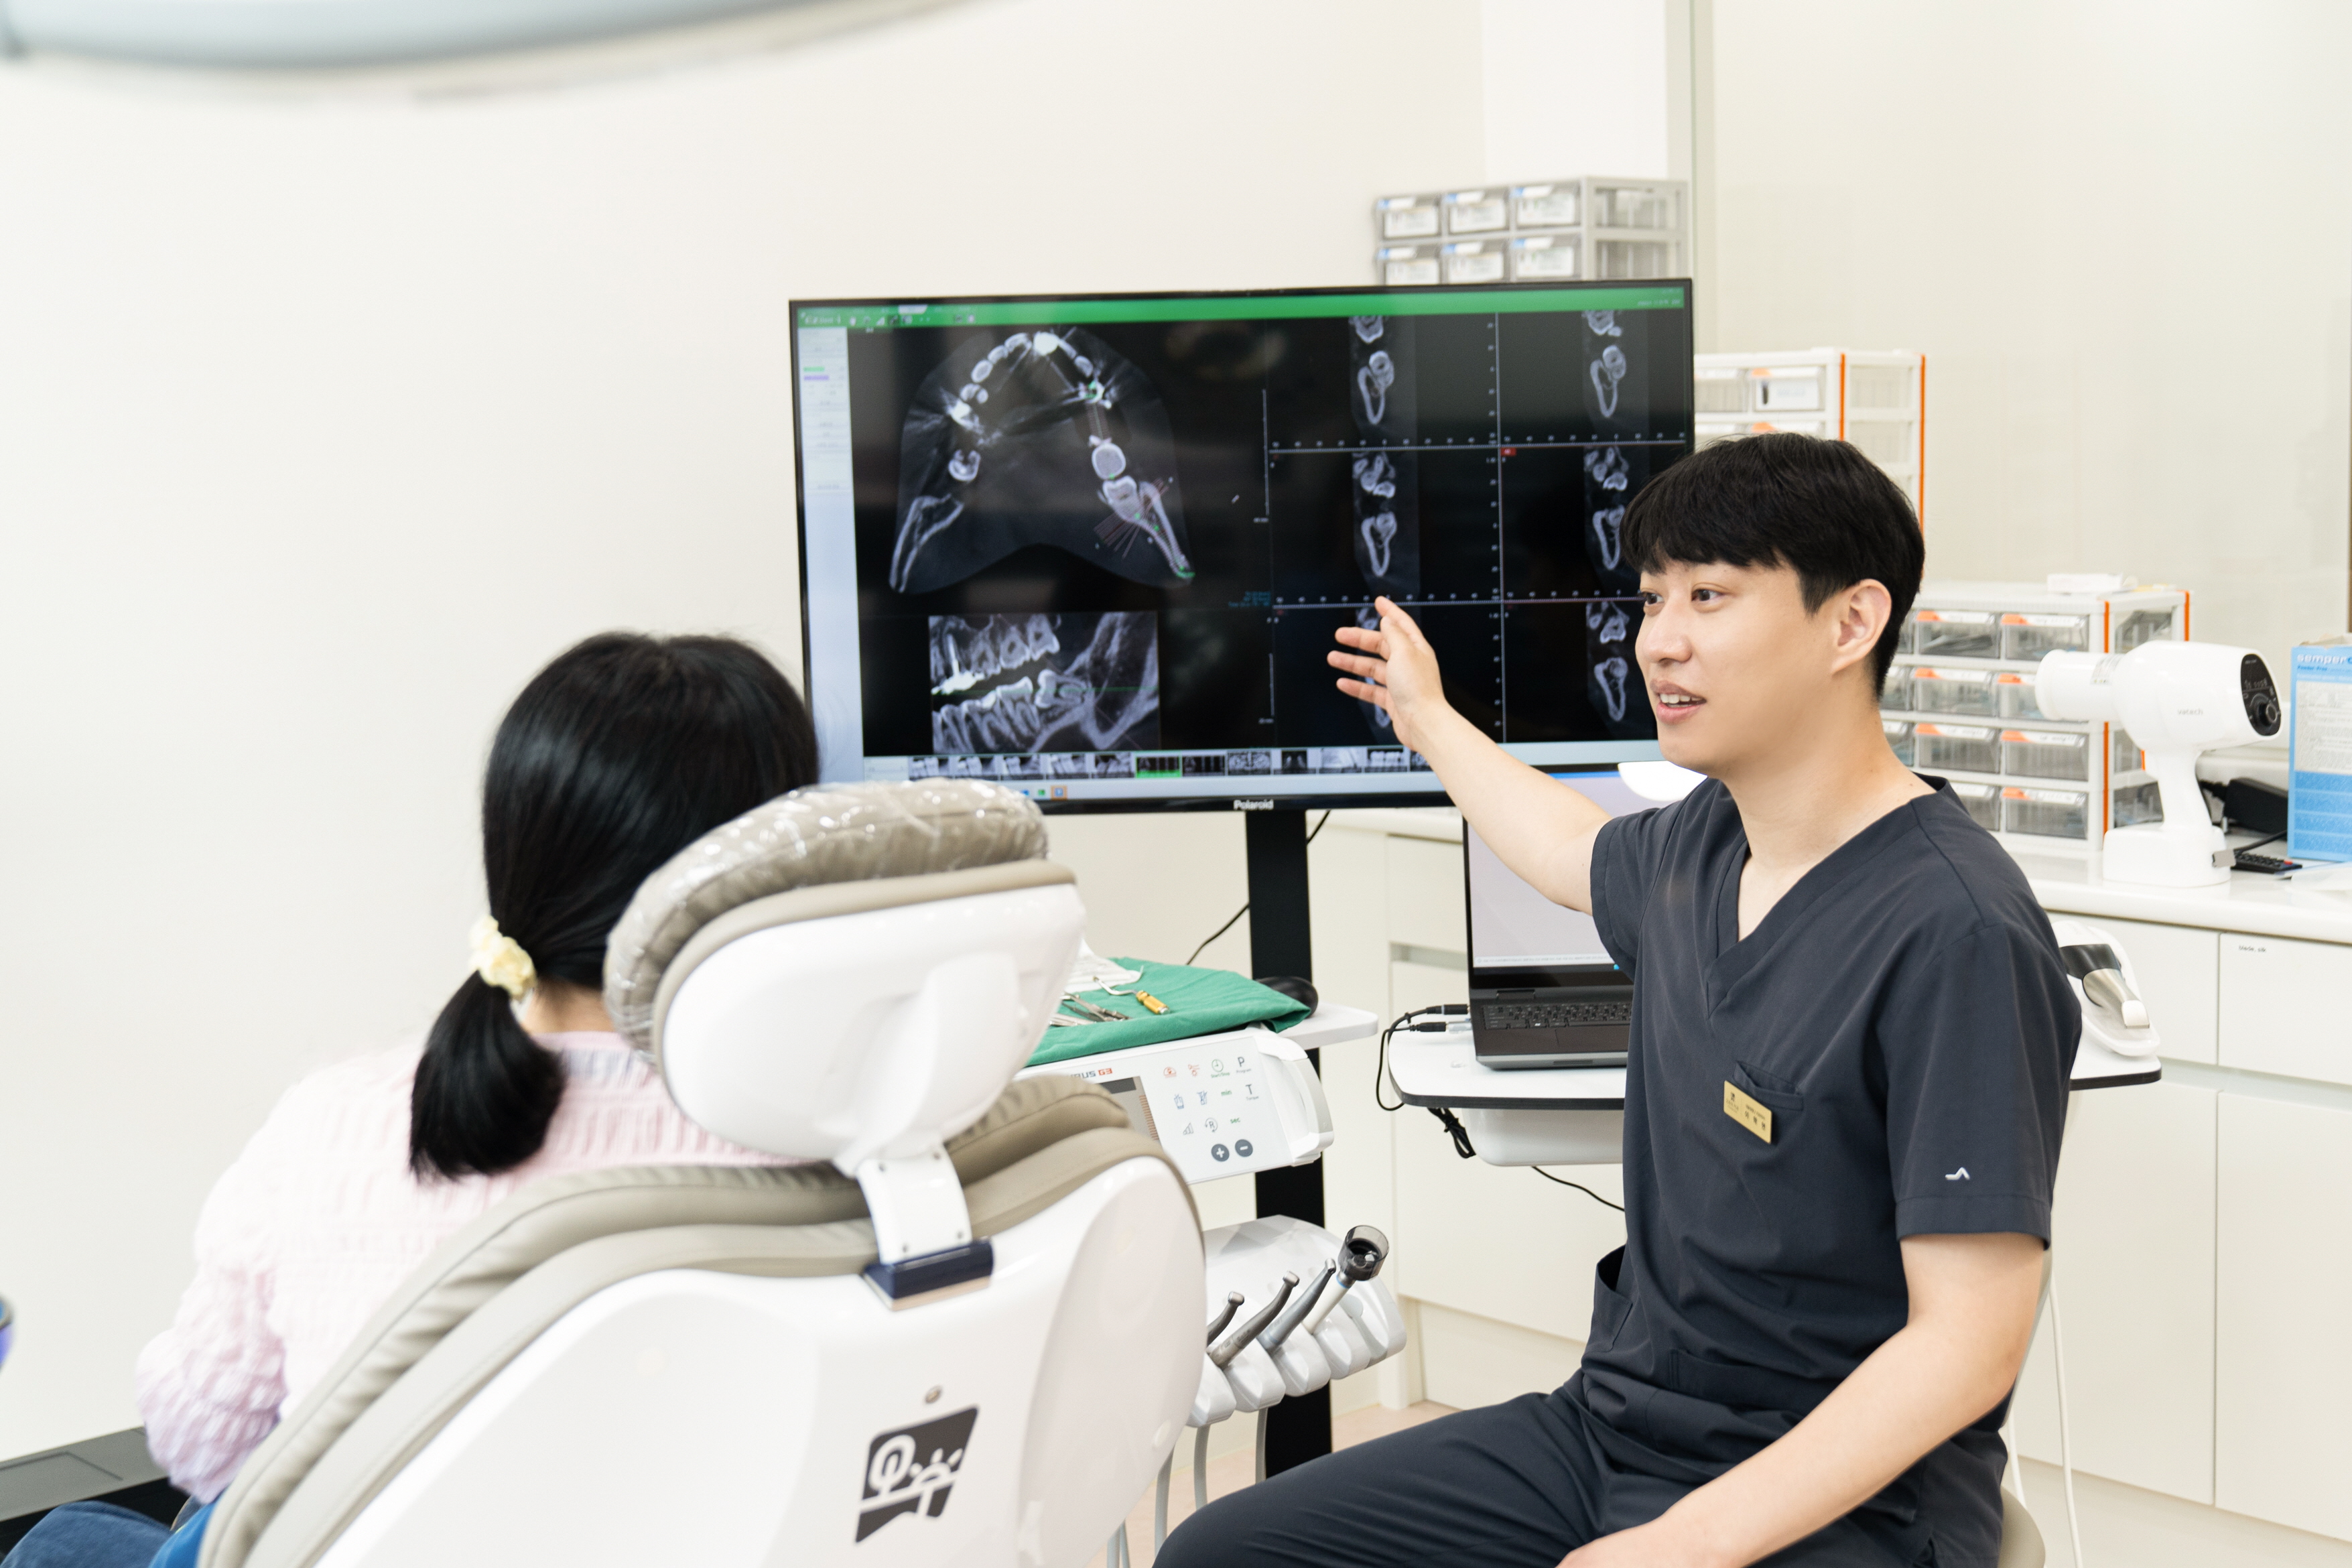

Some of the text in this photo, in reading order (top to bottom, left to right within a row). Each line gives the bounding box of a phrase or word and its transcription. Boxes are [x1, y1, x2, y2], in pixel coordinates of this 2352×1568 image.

[1234, 799, 1273, 810] Polaroid
[1237, 1056, 1245, 1067] P
[1098, 1067, 1112, 1075] G3
[1245, 1084, 1252, 1095] T
